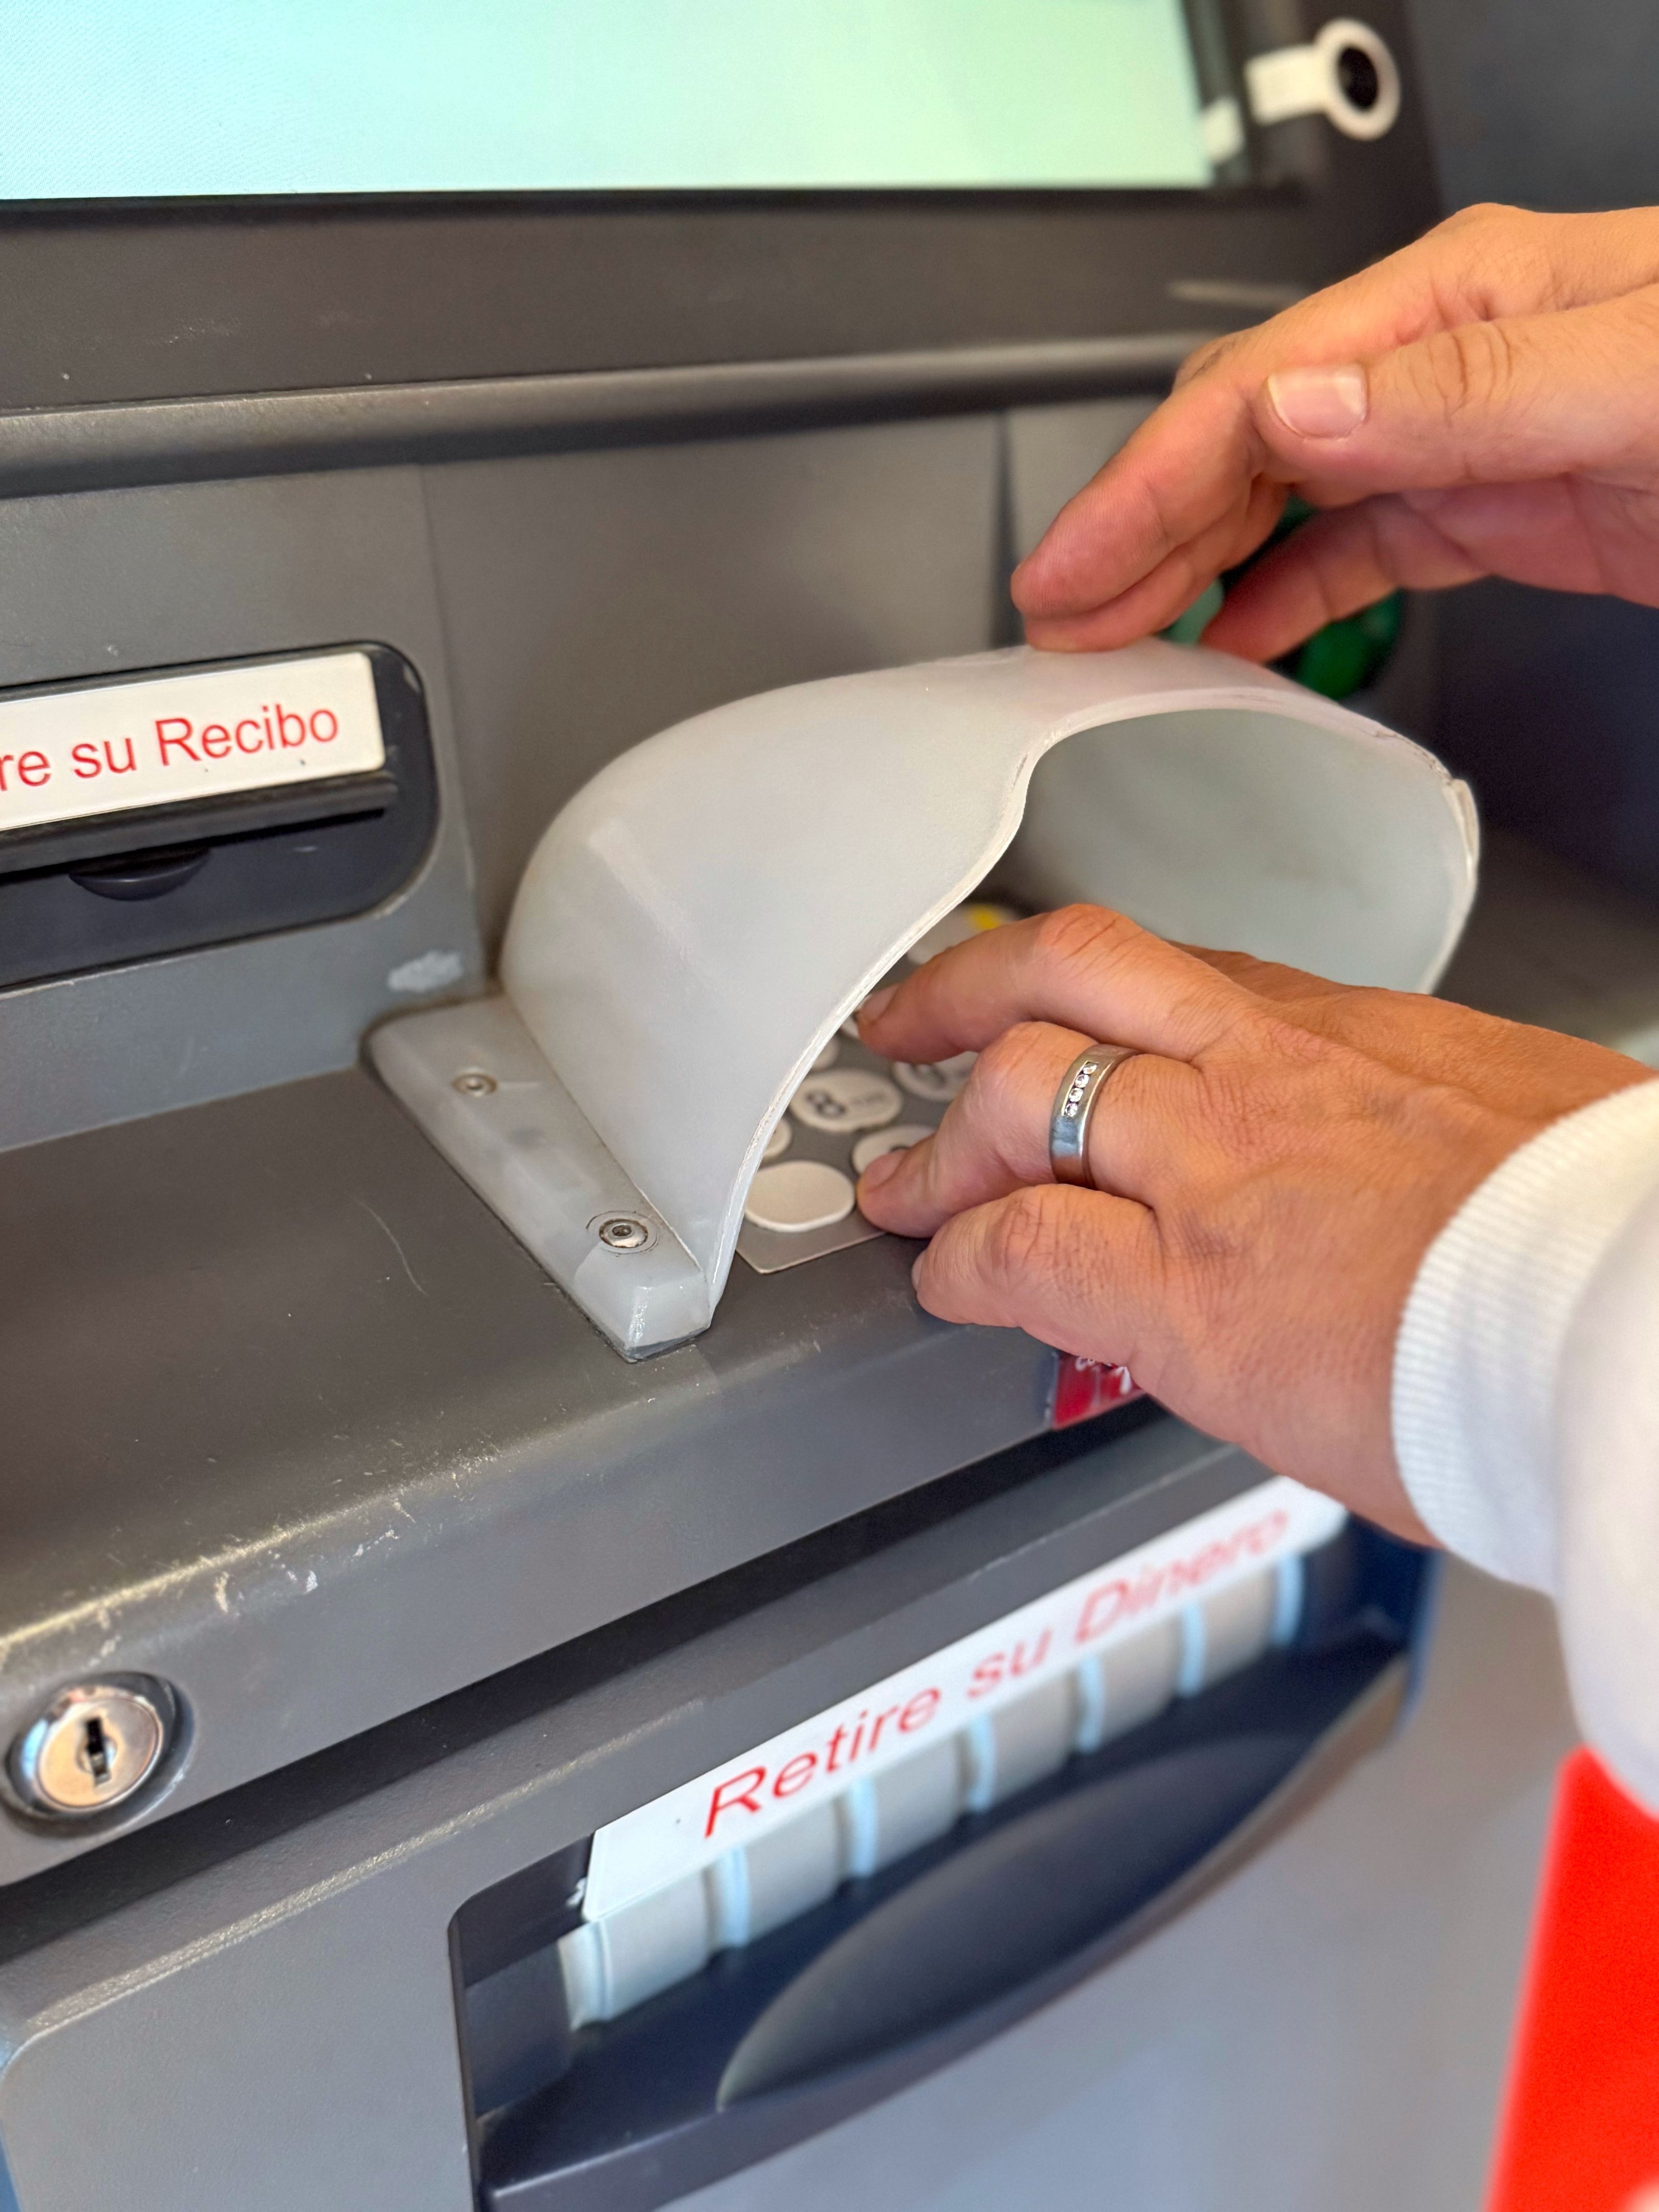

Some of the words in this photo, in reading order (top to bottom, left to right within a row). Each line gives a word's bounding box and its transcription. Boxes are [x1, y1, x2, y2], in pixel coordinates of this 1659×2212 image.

[71, 737, 137, 779] su
[155, 704, 339, 767] Recibo
[805, 1090, 848, 1120] 8
[704, 1687, 941, 1839] Retire
[967, 1628, 1052, 1699] su
[1075, 1510, 1289, 1644] Dinero
